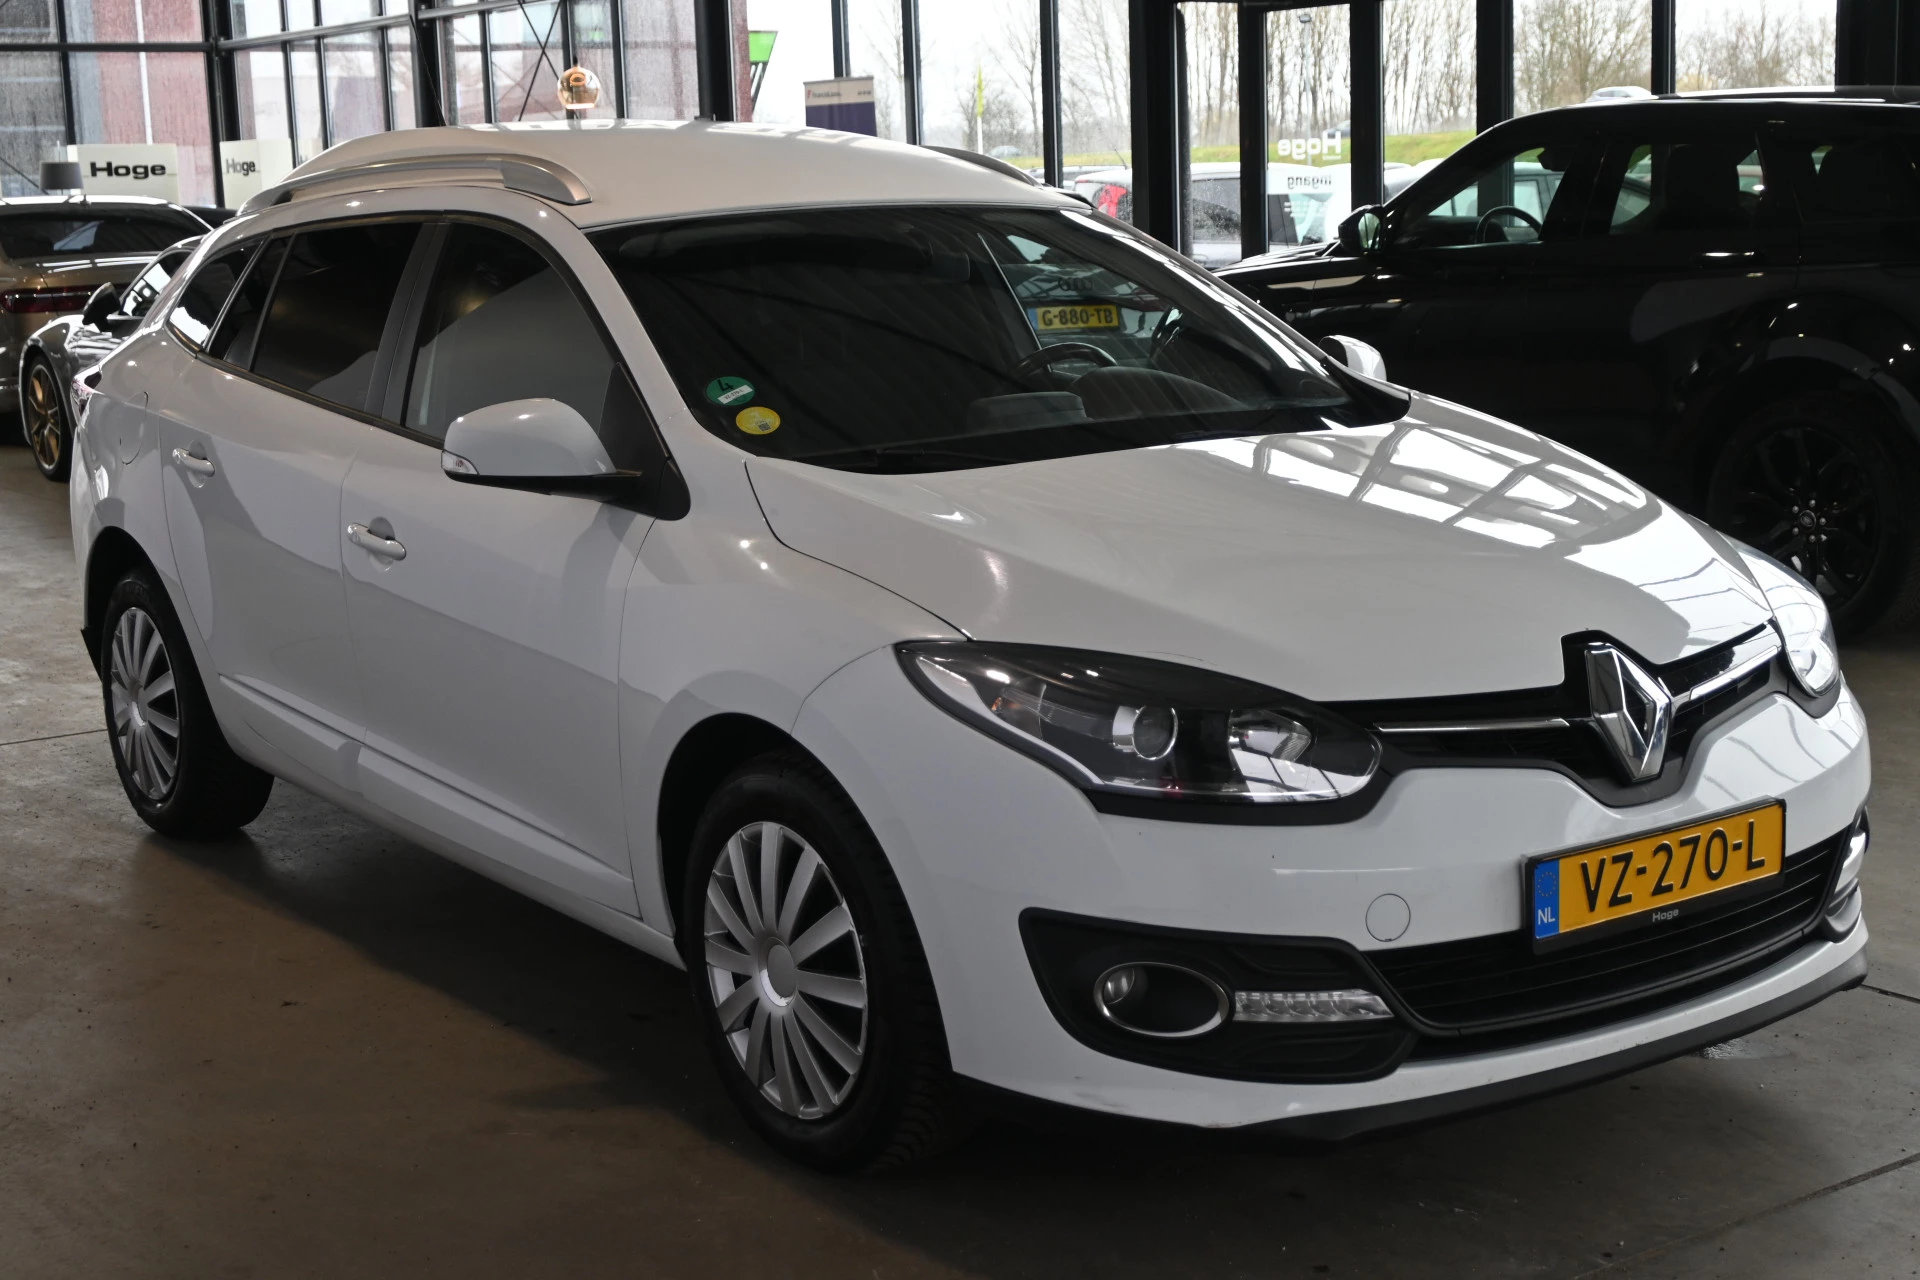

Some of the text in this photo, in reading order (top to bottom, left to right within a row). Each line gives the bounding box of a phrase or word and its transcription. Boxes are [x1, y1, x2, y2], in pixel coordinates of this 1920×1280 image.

[90, 161, 166, 180] Hoge
[226, 158, 256, 176] Hoge
[1042, 307, 1113, 327] G-880-TB
[1580, 819, 1766, 914] VZ-270-L
[1537, 908, 1556, 925] NL
[1652, 906, 1679, 923] Hoge
